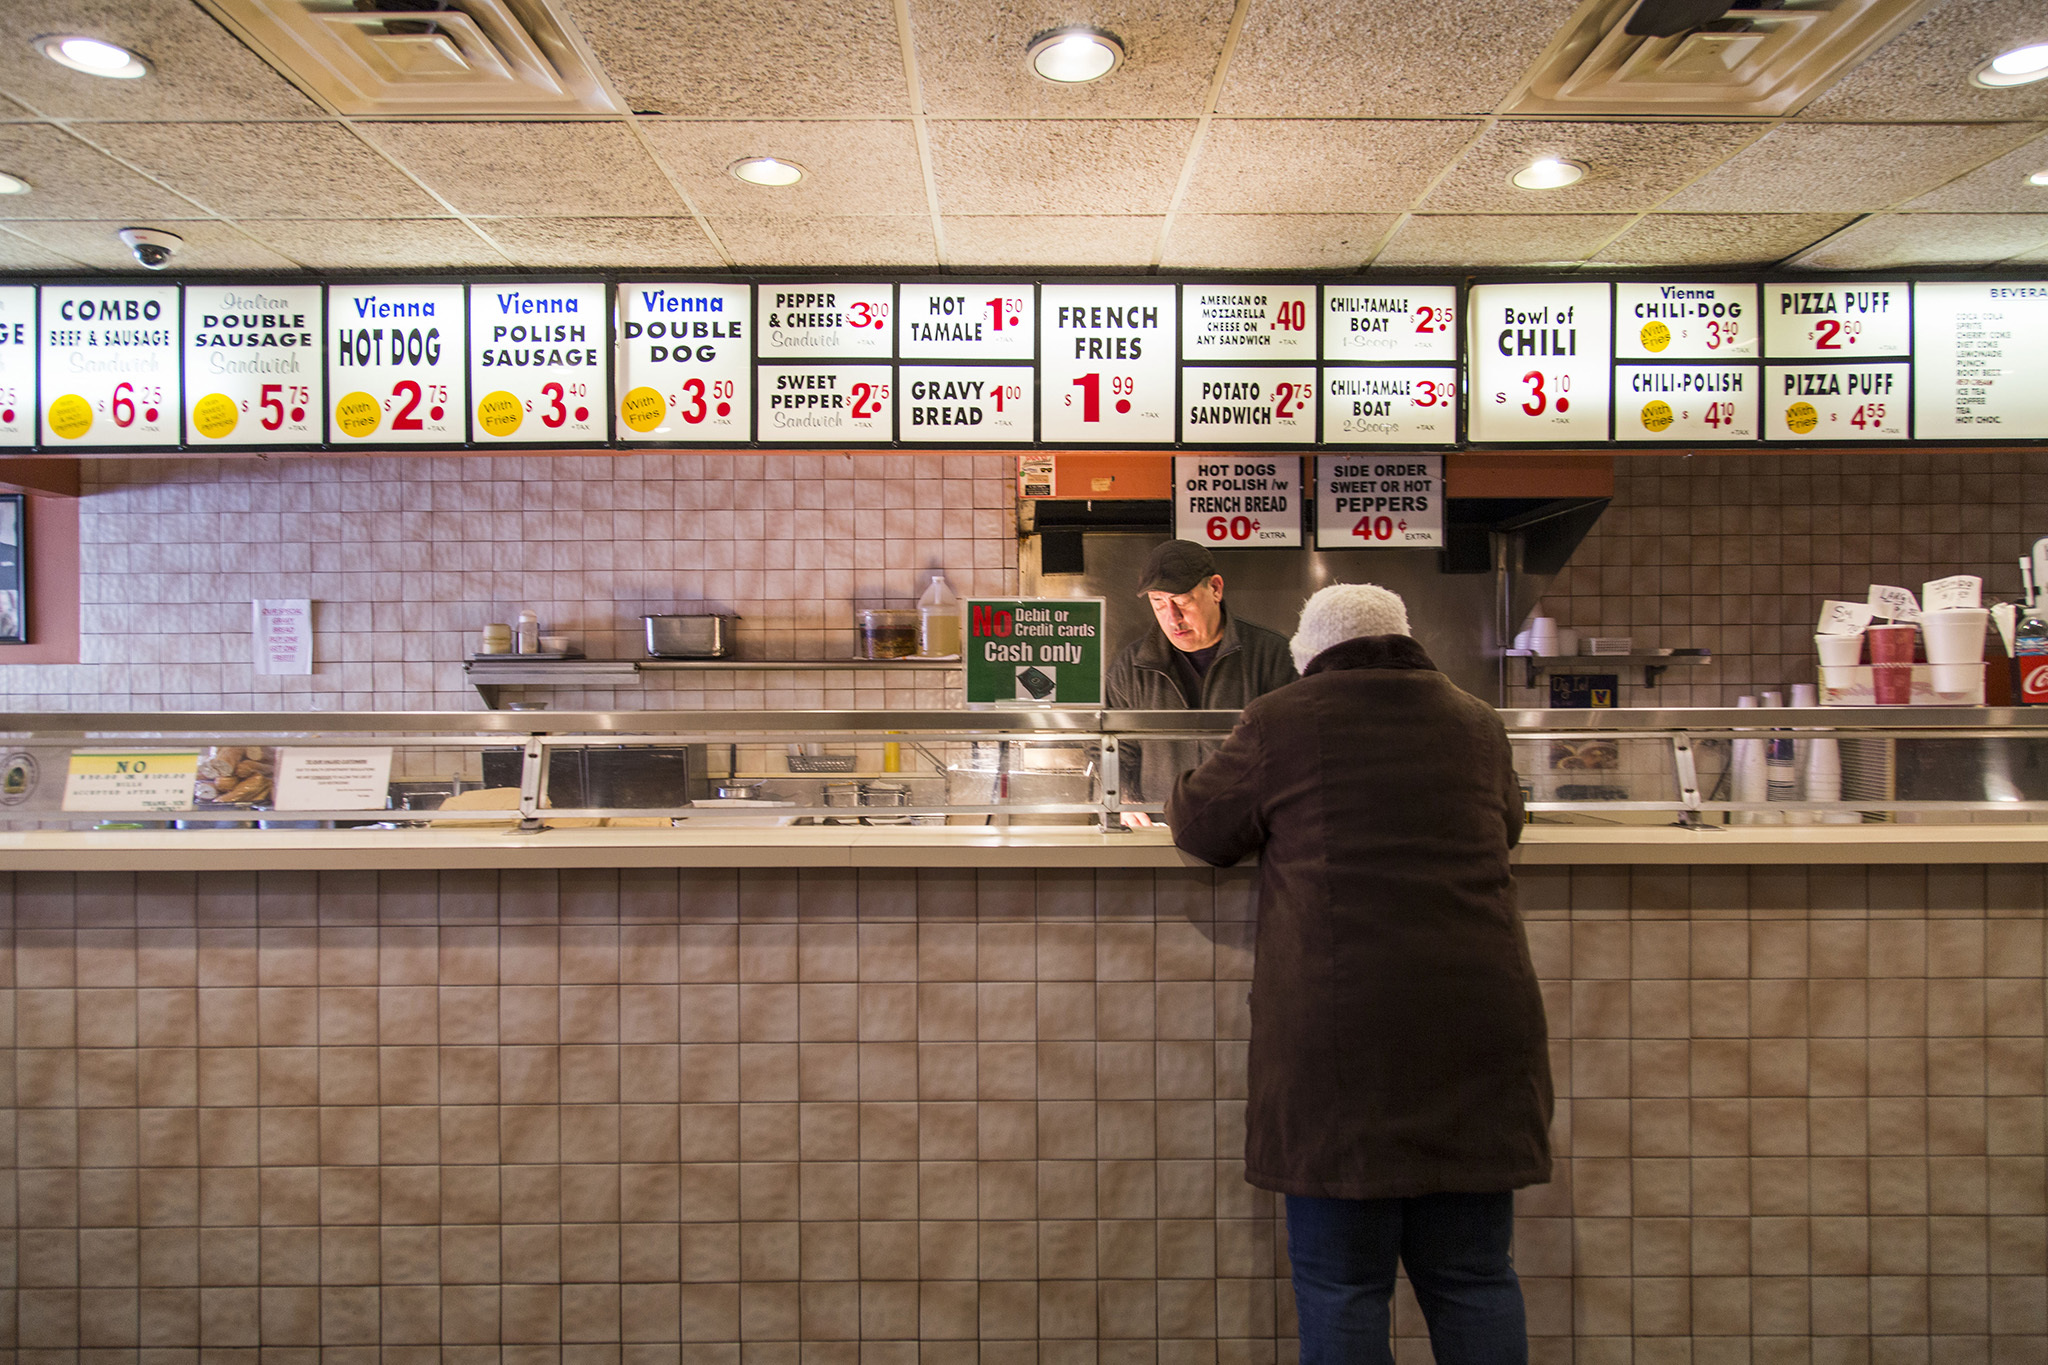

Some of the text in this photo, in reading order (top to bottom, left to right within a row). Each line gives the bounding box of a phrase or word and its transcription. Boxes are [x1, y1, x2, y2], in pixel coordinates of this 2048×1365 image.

[776, 293, 836, 308] PEPPER
[1200, 295, 1267, 306] AMERICAN OR
[1660, 286, 1715, 300] Vienna
[219, 292, 289, 311] Italian
[354, 296, 435, 318] Vienna
[497, 292, 578, 314] Vienna
[642, 290, 723, 312] Vienna
[930, 296, 965, 316] HOT
[1330, 298, 1408, 313] CHILI-TAMALE
[1781, 292, 1890, 315] PIZZA PUFF
[61, 300, 161, 321] COMBO
[1058, 306, 1158, 329] FRENCH
[1202, 308, 1266, 319] MOZZARELLA
[1505, 306, 1574, 324] Bowl of
[1635, 303, 1742, 319] CHILI-DOG
[203, 314, 305, 328] DOUBLE
[769, 313, 842, 328] & CHEESE
[1207, 322, 1258, 332] CHEESE ON
[1350, 318, 1389, 332] BOAT
[1957, 322, 1981, 330] SPRITE
[494, 325, 586, 343] POLISH
[624, 321, 742, 339] DOUBLE
[911, 323, 982, 342] TAMALE
[1640, 324, 1668, 338] With
[50, 330, 170, 346] BEEF & SAUSAGE
[195, 333, 312, 347] SAUSAGE
[771, 331, 840, 348] Sandwich
[1197, 335, 1271, 346] ANY SANDWICH
[1498, 329, 1576, 356] CHILI
[1642, 334, 1672, 347] Fries
[340, 328, 441, 366] HOT DOG
[650, 345, 716, 363] DOG
[1075, 337, 1142, 360] FRIES
[1957, 350, 2002, 358] LEMONADE
[69, 352, 160, 374] Sandwich
[209, 352, 300, 375] Sandwich
[482, 349, 597, 367] SAUSAGE
[777, 375, 837, 390] SWEET
[1330, 380, 1411, 396] CHILI-TAMALE
[1632, 373, 1743, 392] CHILI-POLISH
[1785, 373, 1893, 395] PIZZA PUFF
[911, 381, 985, 400] GRAVY
[1202, 382, 1260, 400] POTATO
[483, 400, 513, 414] With
[626, 395, 656, 411] With
[771, 394, 844, 409] PEPPER
[1956, 397, 1985, 405] COFFEE
[340, 402, 371, 417] With
[912, 407, 983, 426] BREAD
[1190, 406, 1271, 425] SANDWICH
[1353, 401, 1391, 417] BOAT
[1642, 404, 1670, 418] With
[1785, 405, 1815, 419] With
[343, 416, 375, 430] Fries
[486, 413, 517, 428] Fries
[629, 409, 660, 425] Fries
[773, 412, 843, 429] Sandwich
[1643, 413, 1674, 427] Fries
[1787, 416, 1818, 430] Fries
[1956, 416, 1973, 424] HOT
[1198, 464, 1276, 476] HOT DOGS
[1334, 465, 1427, 477] SIDE ORDER
[1187, 480, 1207, 491] OR
[1213, 479, 1267, 490] POLISH
[1331, 480, 1431, 493] SWEET OR HOT
[1190, 496, 1287, 512] FRENCH BREAD
[1336, 497, 1428, 512] PEPPERS
[1015, 608, 1050, 622] Debit
[1054, 611, 1069, 622] or
[1015, 623, 1095, 637] Credit cards
[984, 641, 1082, 664] Cash only
[116, 761, 147, 773] NO
